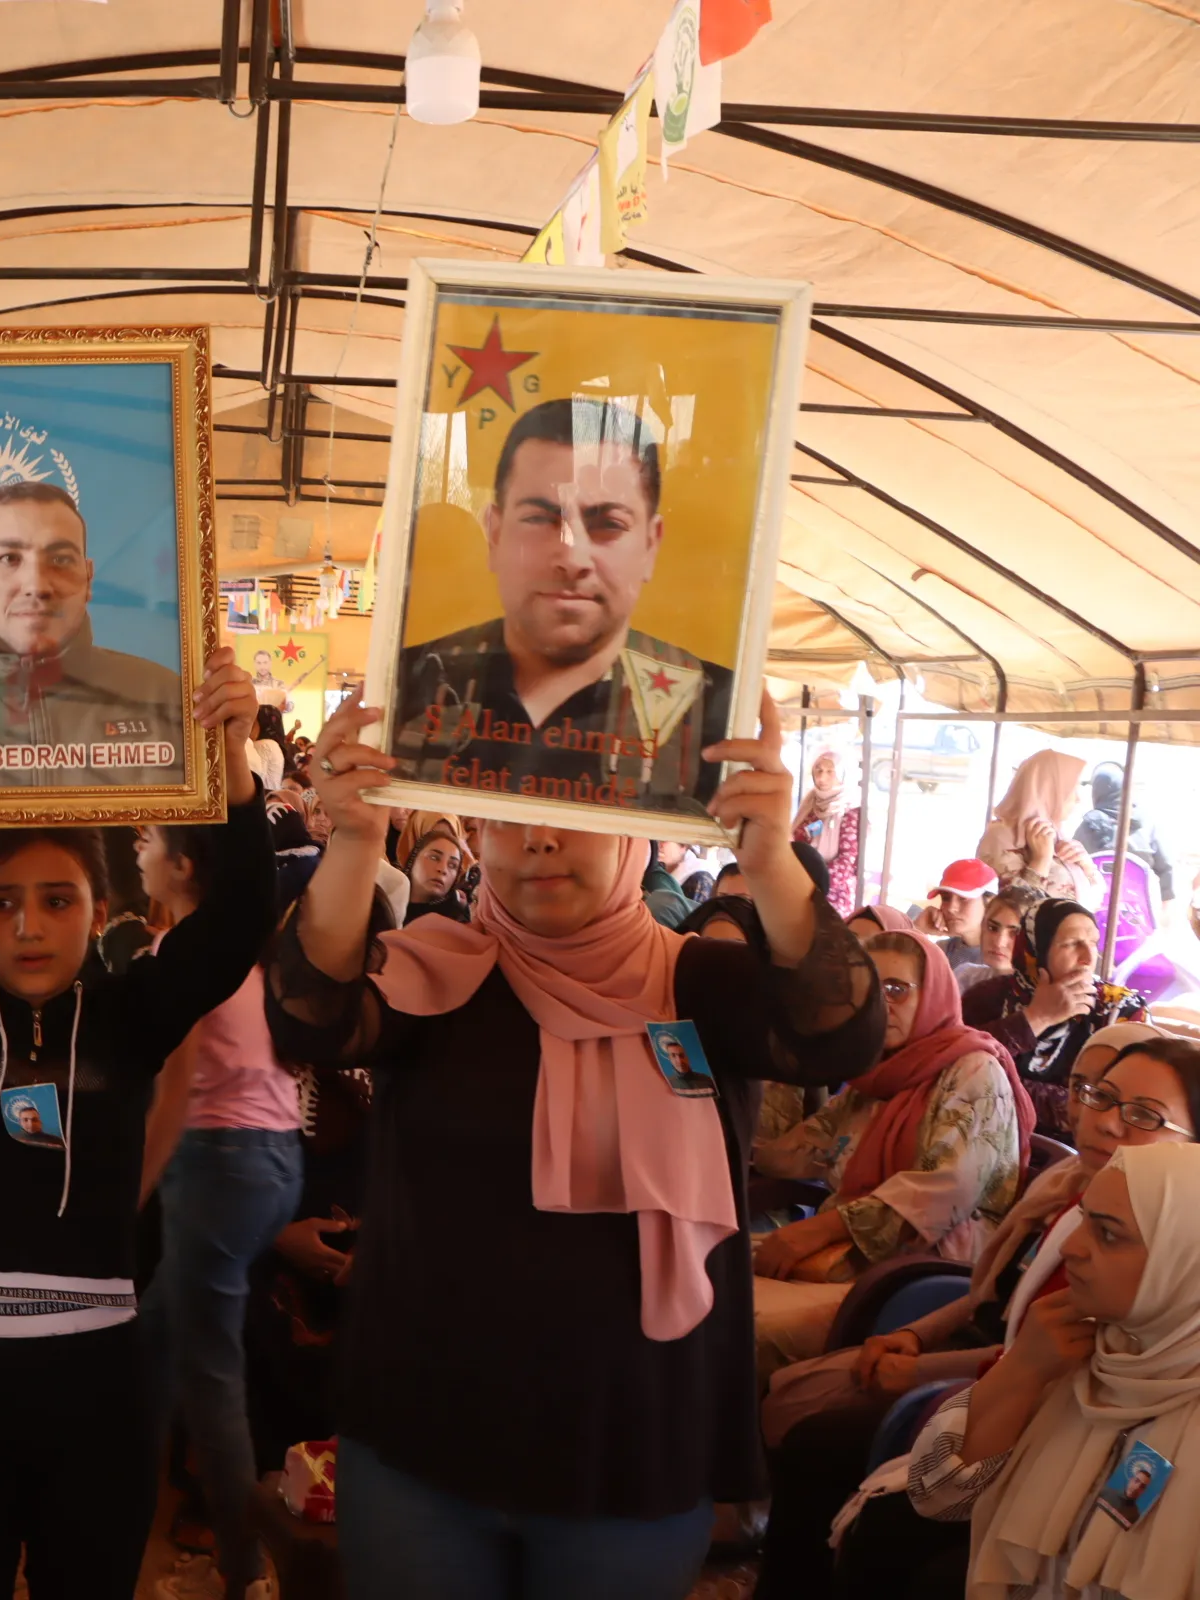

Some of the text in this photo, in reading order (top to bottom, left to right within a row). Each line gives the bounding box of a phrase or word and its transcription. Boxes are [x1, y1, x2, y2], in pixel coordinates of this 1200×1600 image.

[452, 708, 532, 745] Alan
[543, 716, 660, 760] ehmed
[91, 741, 176, 769] EHMED
[442, 755, 511, 793] felat
